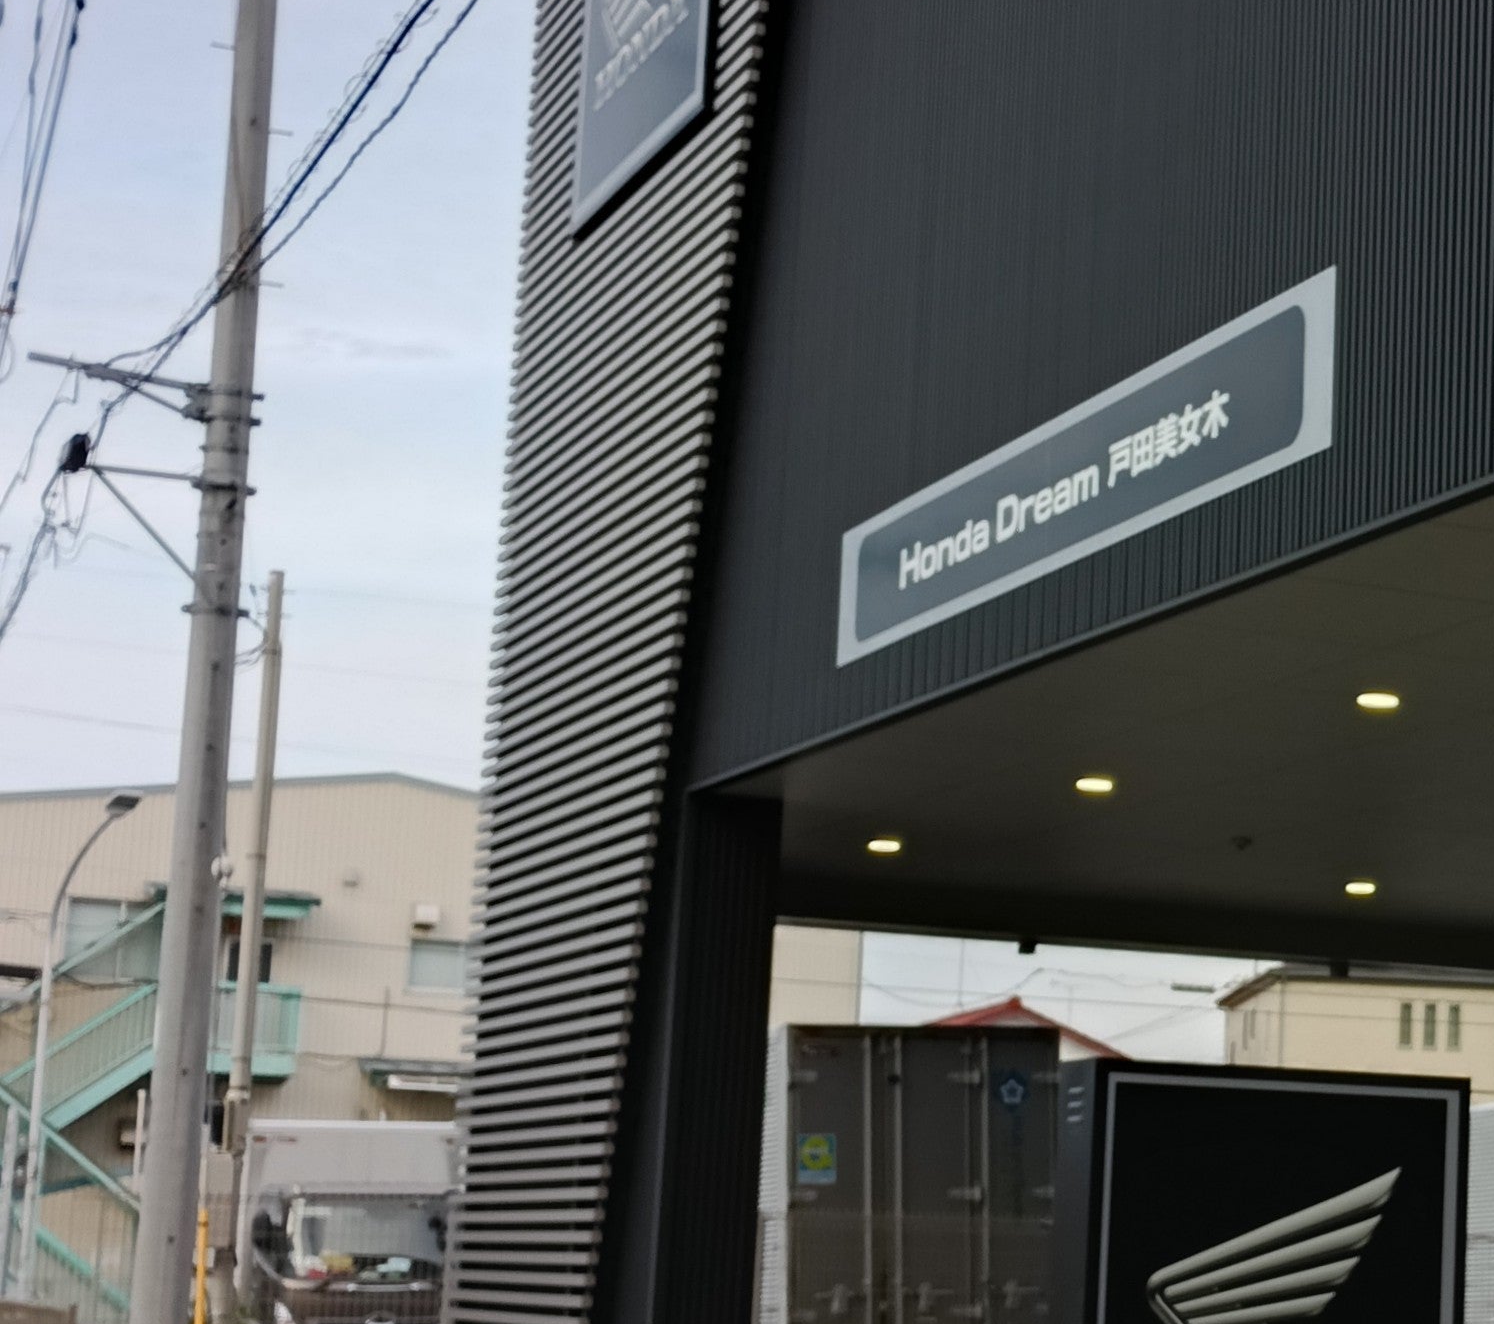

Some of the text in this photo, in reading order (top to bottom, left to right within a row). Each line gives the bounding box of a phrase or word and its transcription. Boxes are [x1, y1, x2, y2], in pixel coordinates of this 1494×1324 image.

[898, 390, 1230, 590] Honda Dream 戸田美女木
